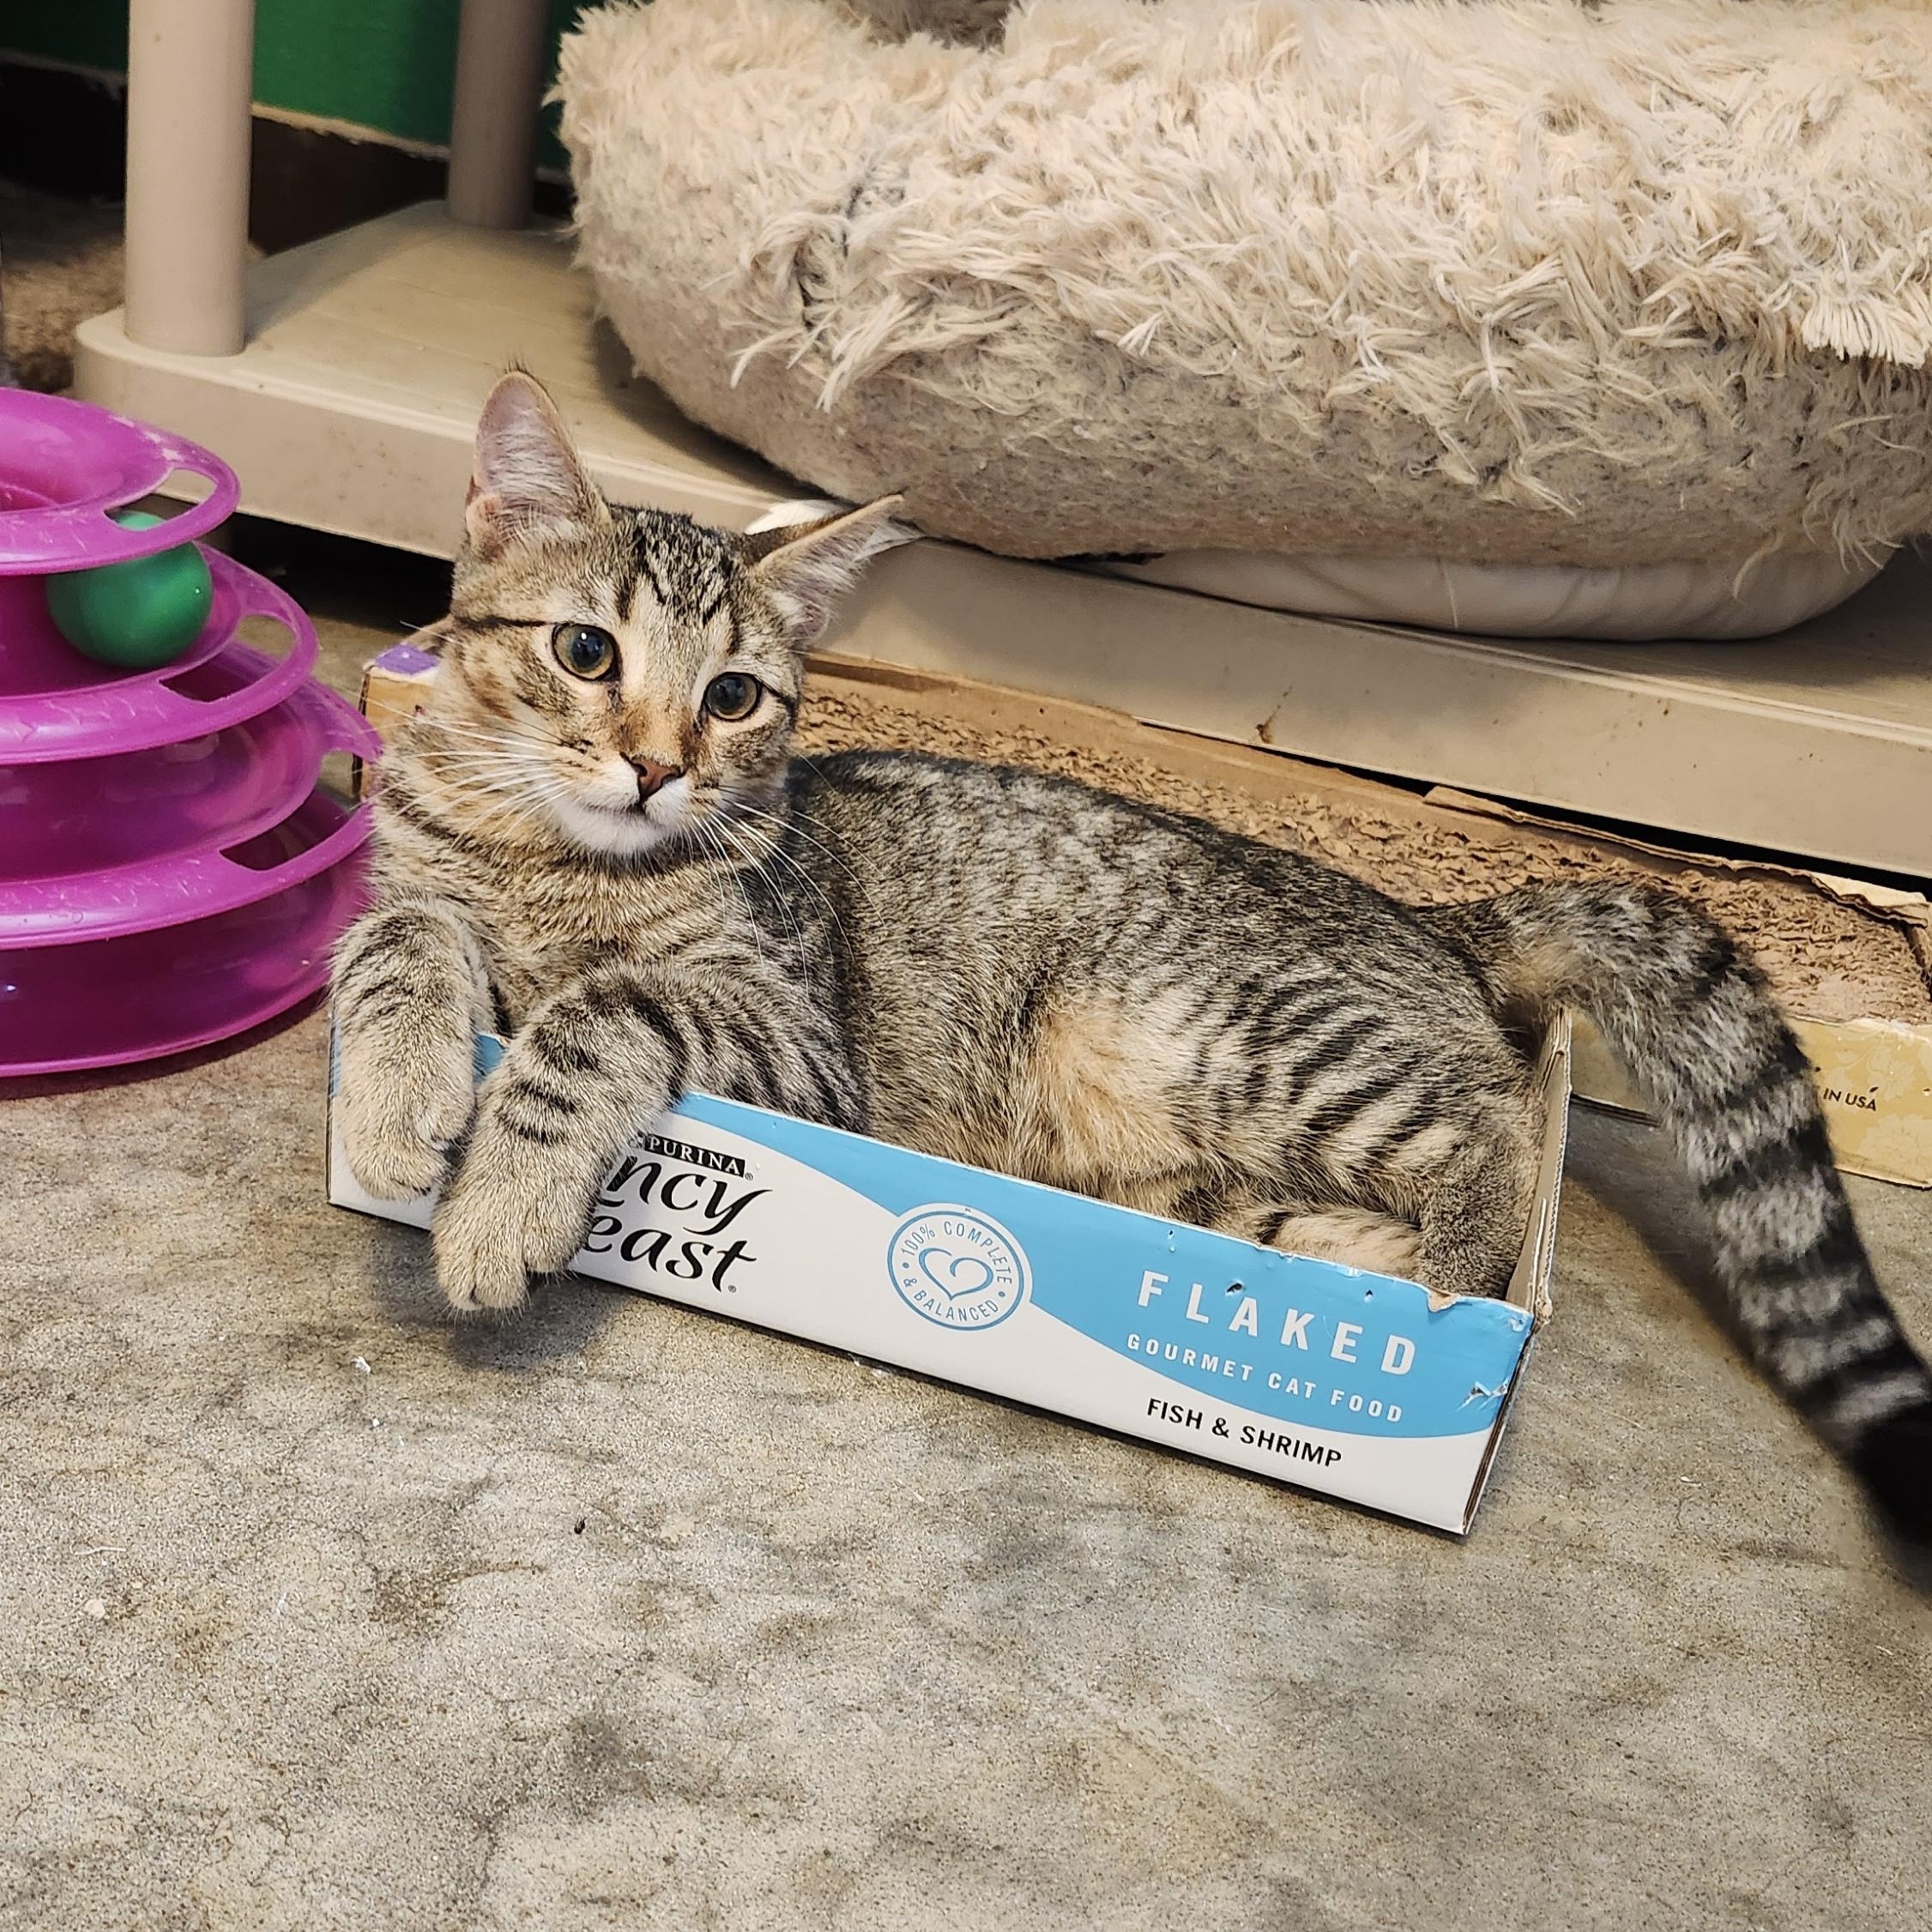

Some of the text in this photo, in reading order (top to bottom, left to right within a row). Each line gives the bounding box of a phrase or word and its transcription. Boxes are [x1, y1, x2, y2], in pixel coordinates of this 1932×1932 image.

[1823, 1088, 1876, 1111] IN USA
[649, 1136, 740, 1175] PURINA
[604, 1156, 773, 1235] ncy
[584, 1216, 757, 1293] east
[902, 1221, 1012, 1284] 100% COMPLETE
[903, 1277, 999, 1322] & BALANCED
[1138, 1270, 1416, 1375] FLAKED
[1127, 1333, 1402, 1422] GOURMET CAT FOOD
[1147, 1398, 1342, 1467] FISH & SHRIMP
